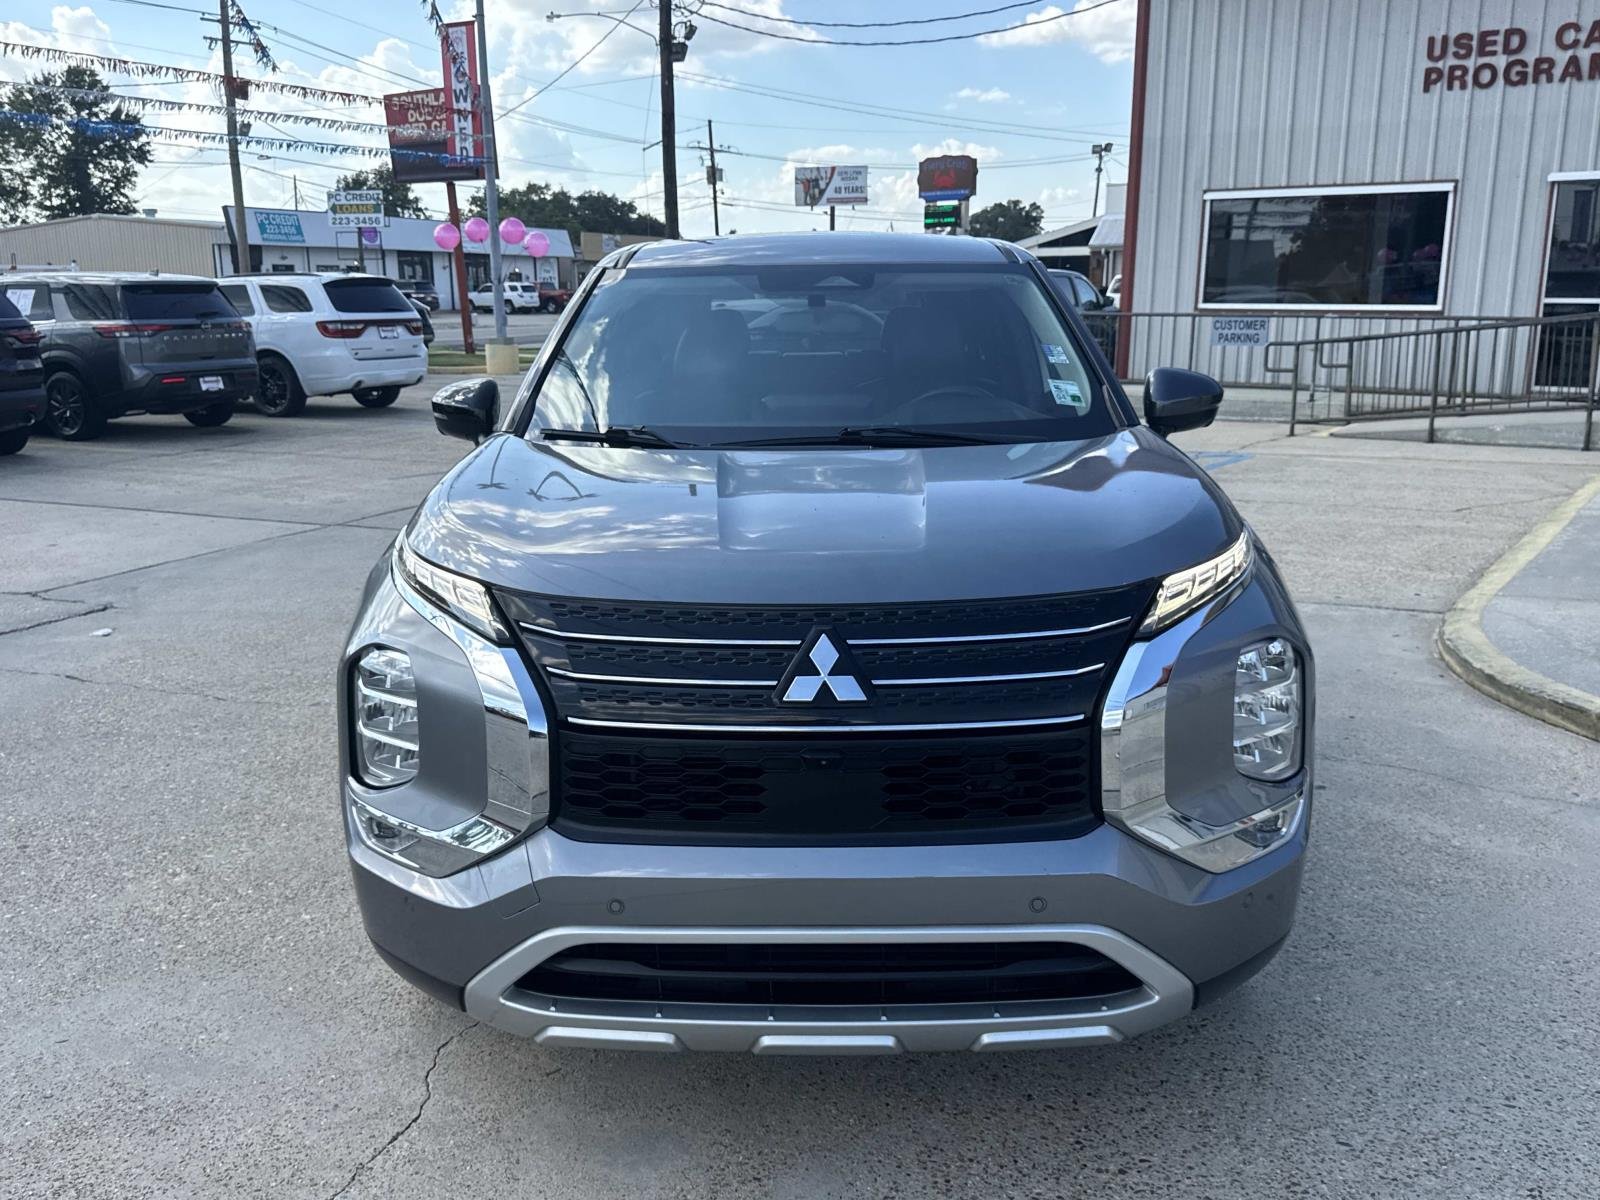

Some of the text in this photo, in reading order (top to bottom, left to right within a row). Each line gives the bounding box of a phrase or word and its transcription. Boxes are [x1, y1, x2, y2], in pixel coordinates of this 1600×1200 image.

[1427, 28, 1527, 62] USED
[328, 192, 382, 202] PC CREDIT
[336, 204, 375, 214] LOANS
[255, 212, 299, 226] PC CREDIT
[331, 216, 381, 226] 223-3456
[1213, 319, 1267, 331] CUSTOMER
[1217, 332, 1260, 344] PARKING
